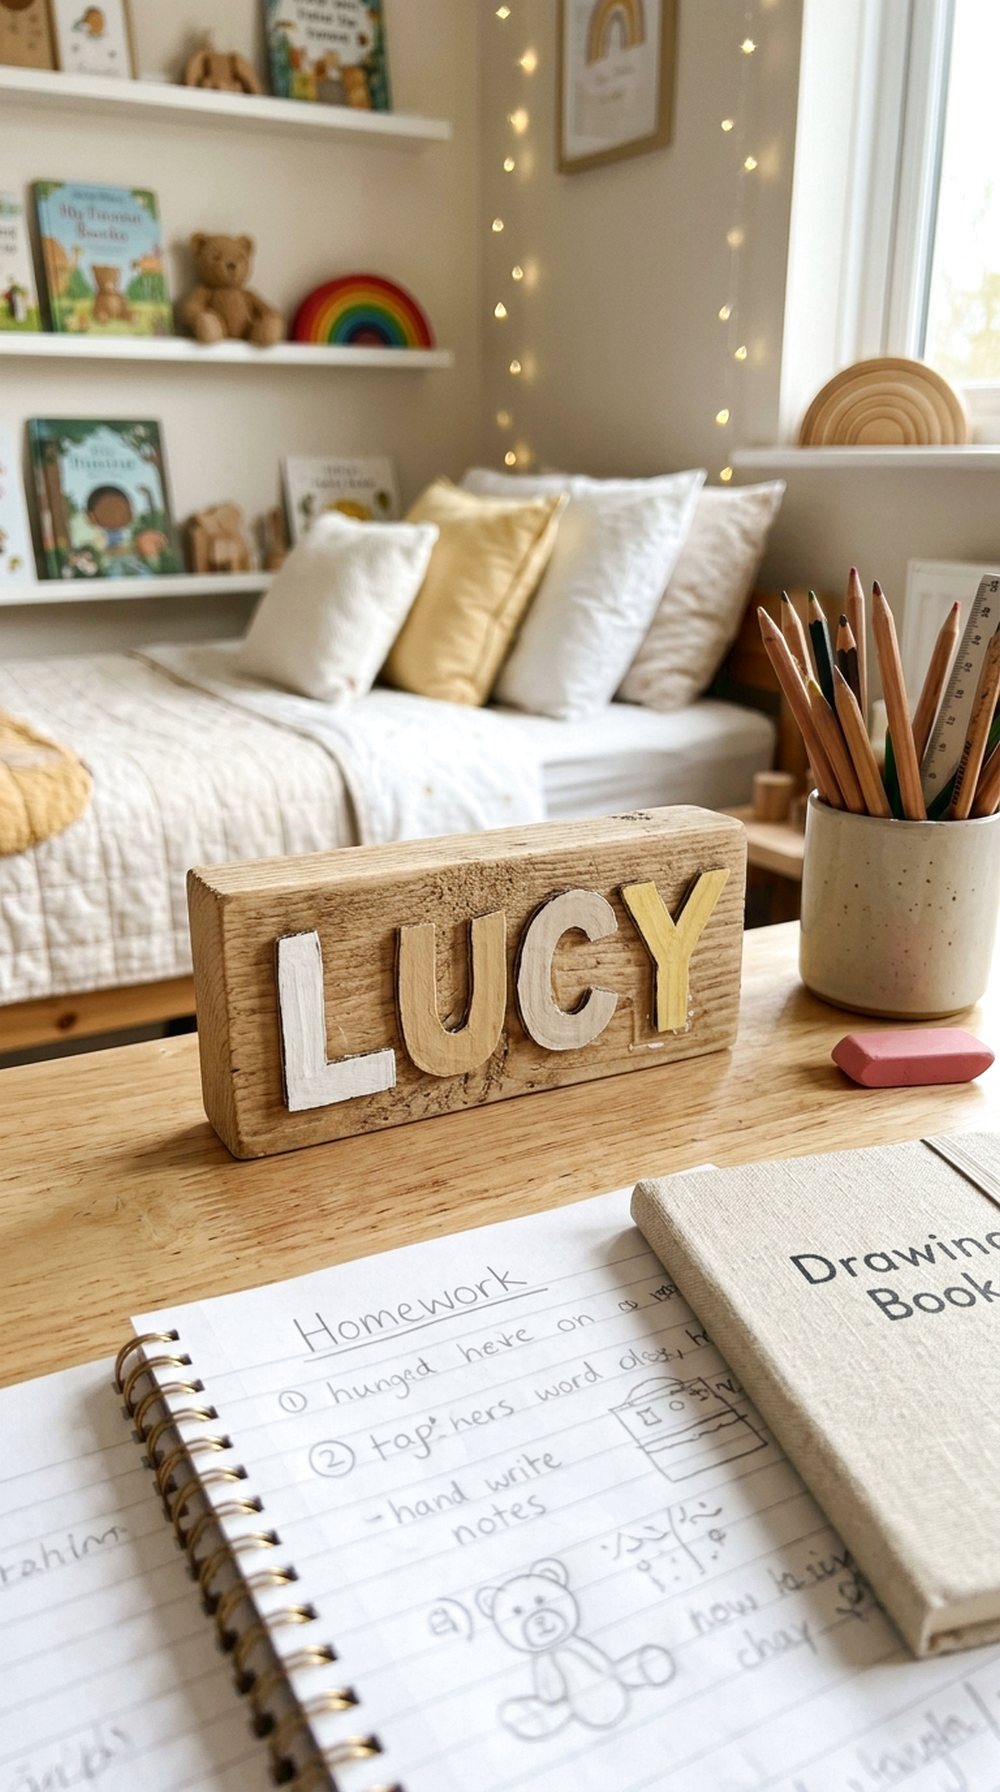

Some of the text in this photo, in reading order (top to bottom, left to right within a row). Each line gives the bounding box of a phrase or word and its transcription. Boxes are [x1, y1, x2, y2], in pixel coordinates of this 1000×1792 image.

[275, 868, 731, 1113] LUCY
[292, 1265, 528, 1353] Homework
[866, 1272, 1000, 1321] Book
[557, 1312, 595, 1333] on
[535, 1361, 604, 1402] word
[484, 1453, 562, 1492] write
[451, 1494, 547, 1545] notes
